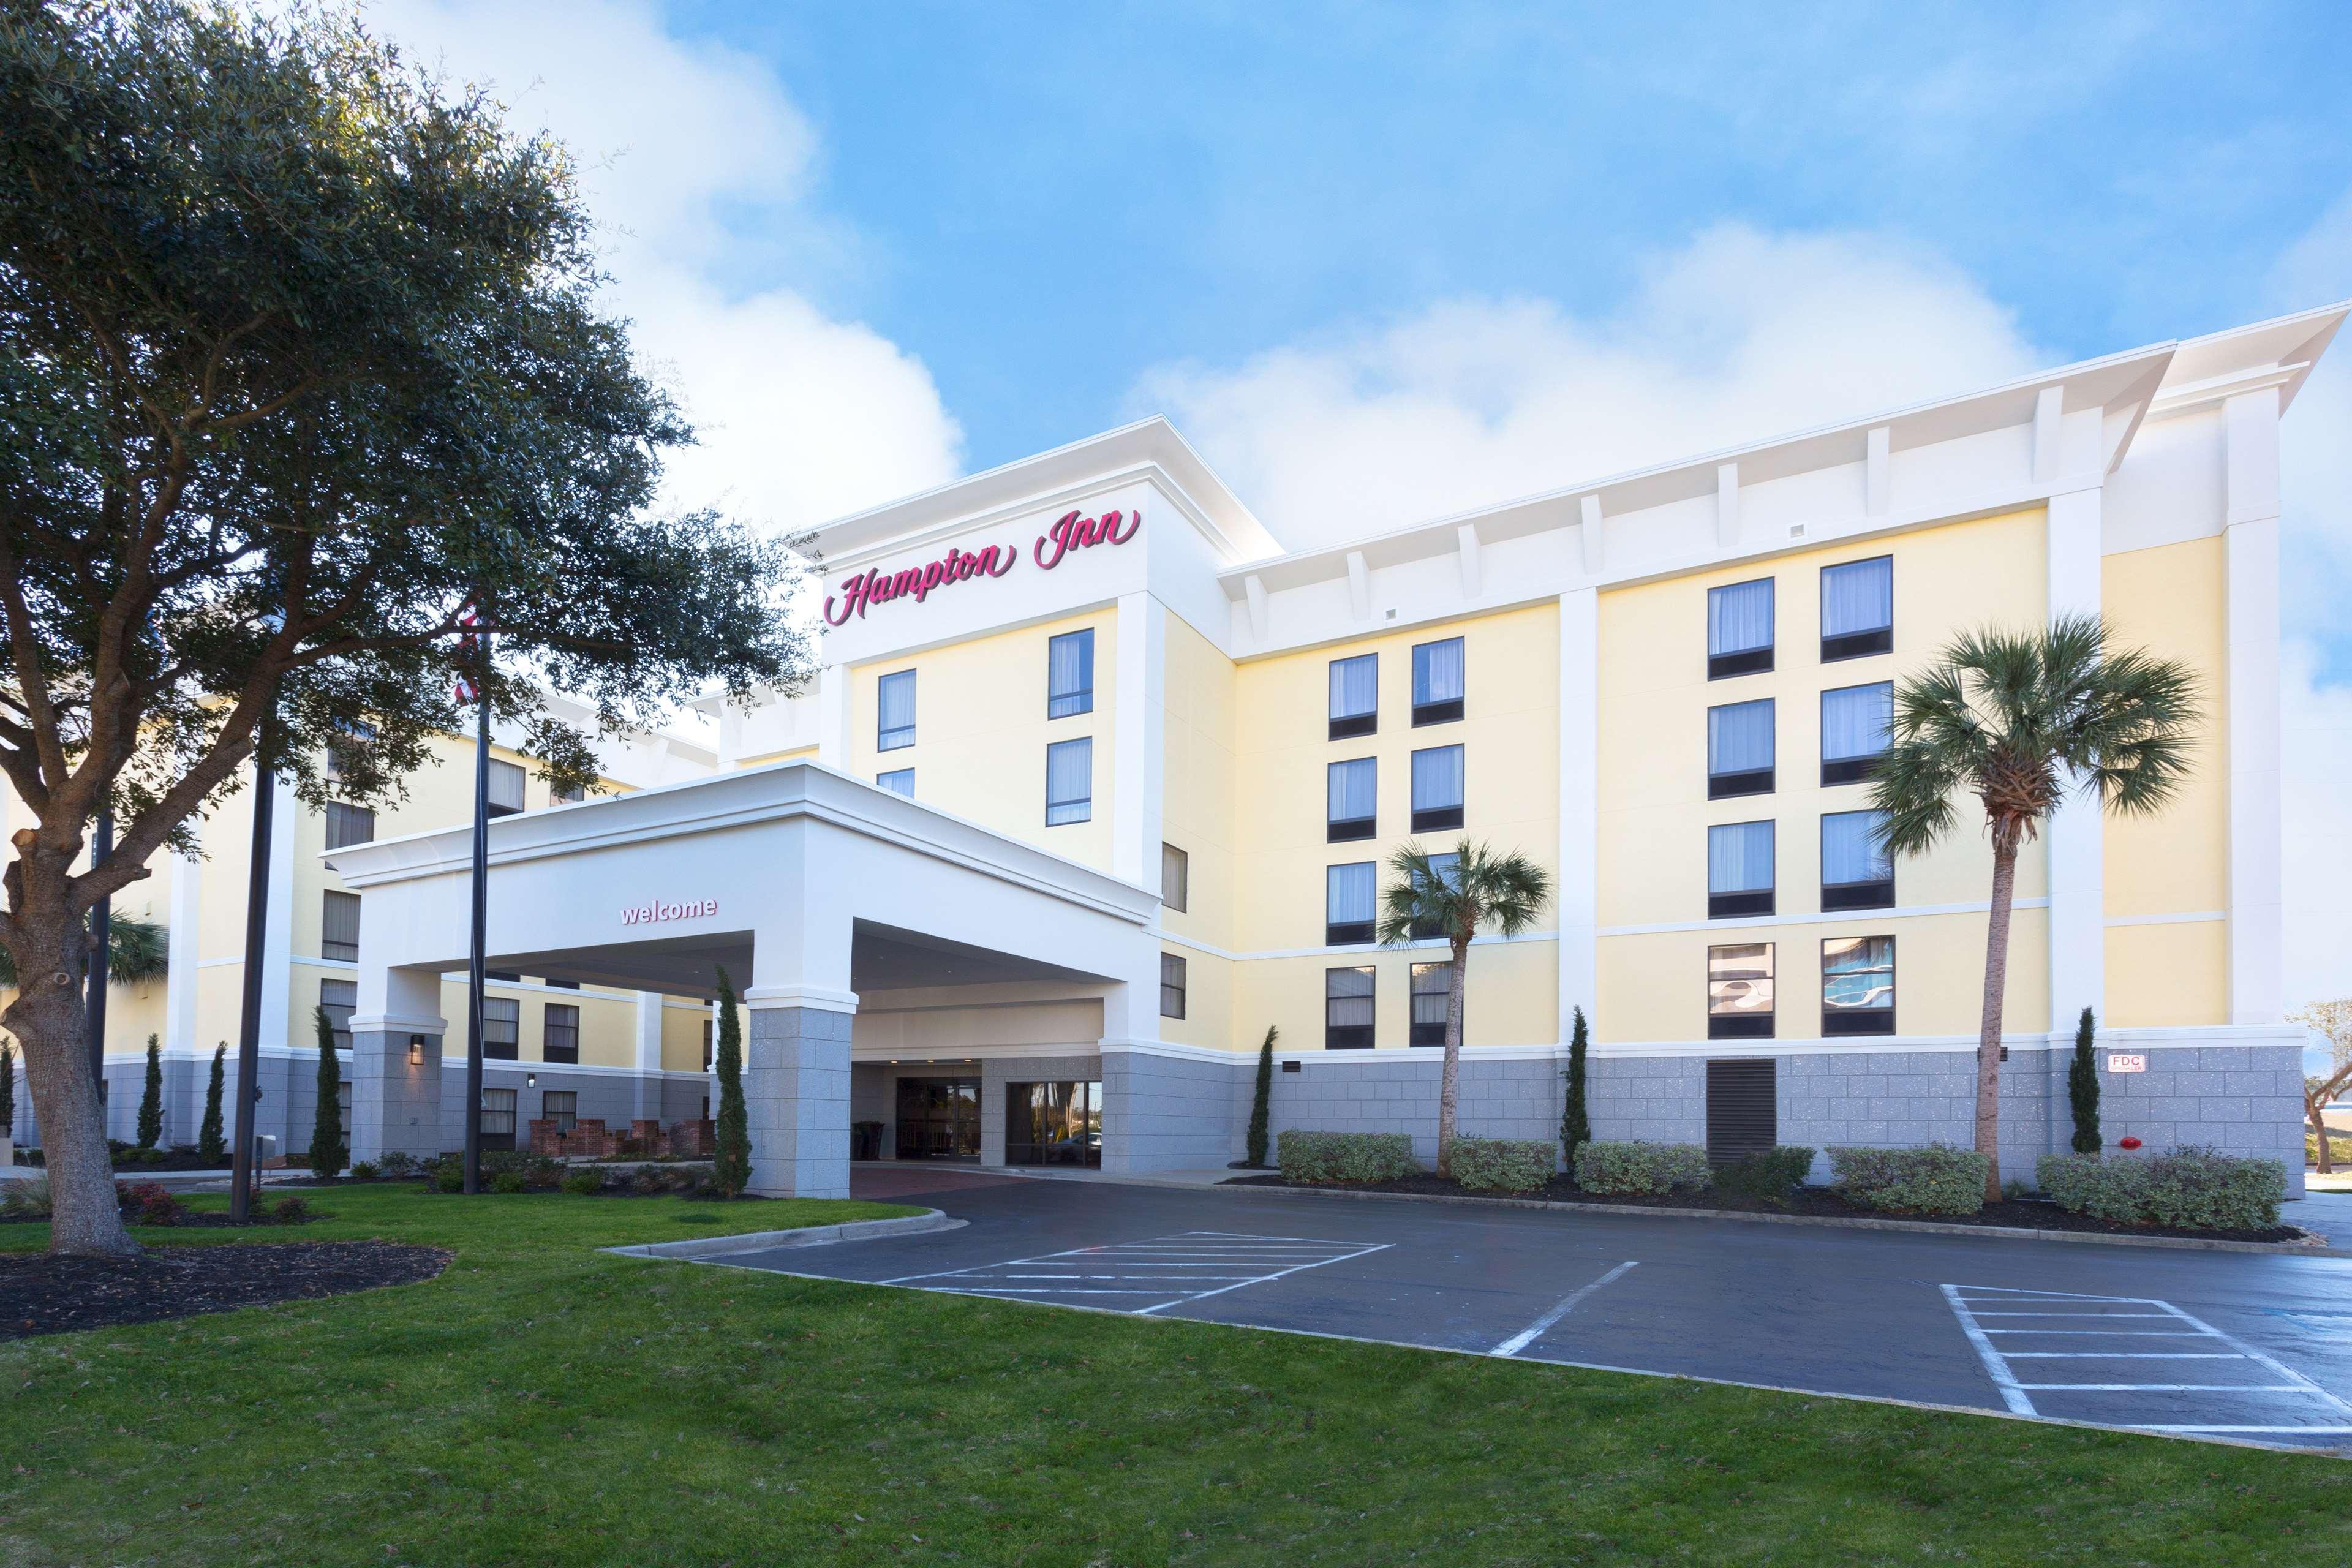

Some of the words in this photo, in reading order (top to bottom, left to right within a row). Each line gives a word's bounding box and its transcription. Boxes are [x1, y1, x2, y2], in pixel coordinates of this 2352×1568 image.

[824, 544, 1017, 626] Hampton
[1033, 509, 1140, 570] Inn
[620, 899, 717, 925] welcome
[2113, 1057, 2140, 1066] FDC
